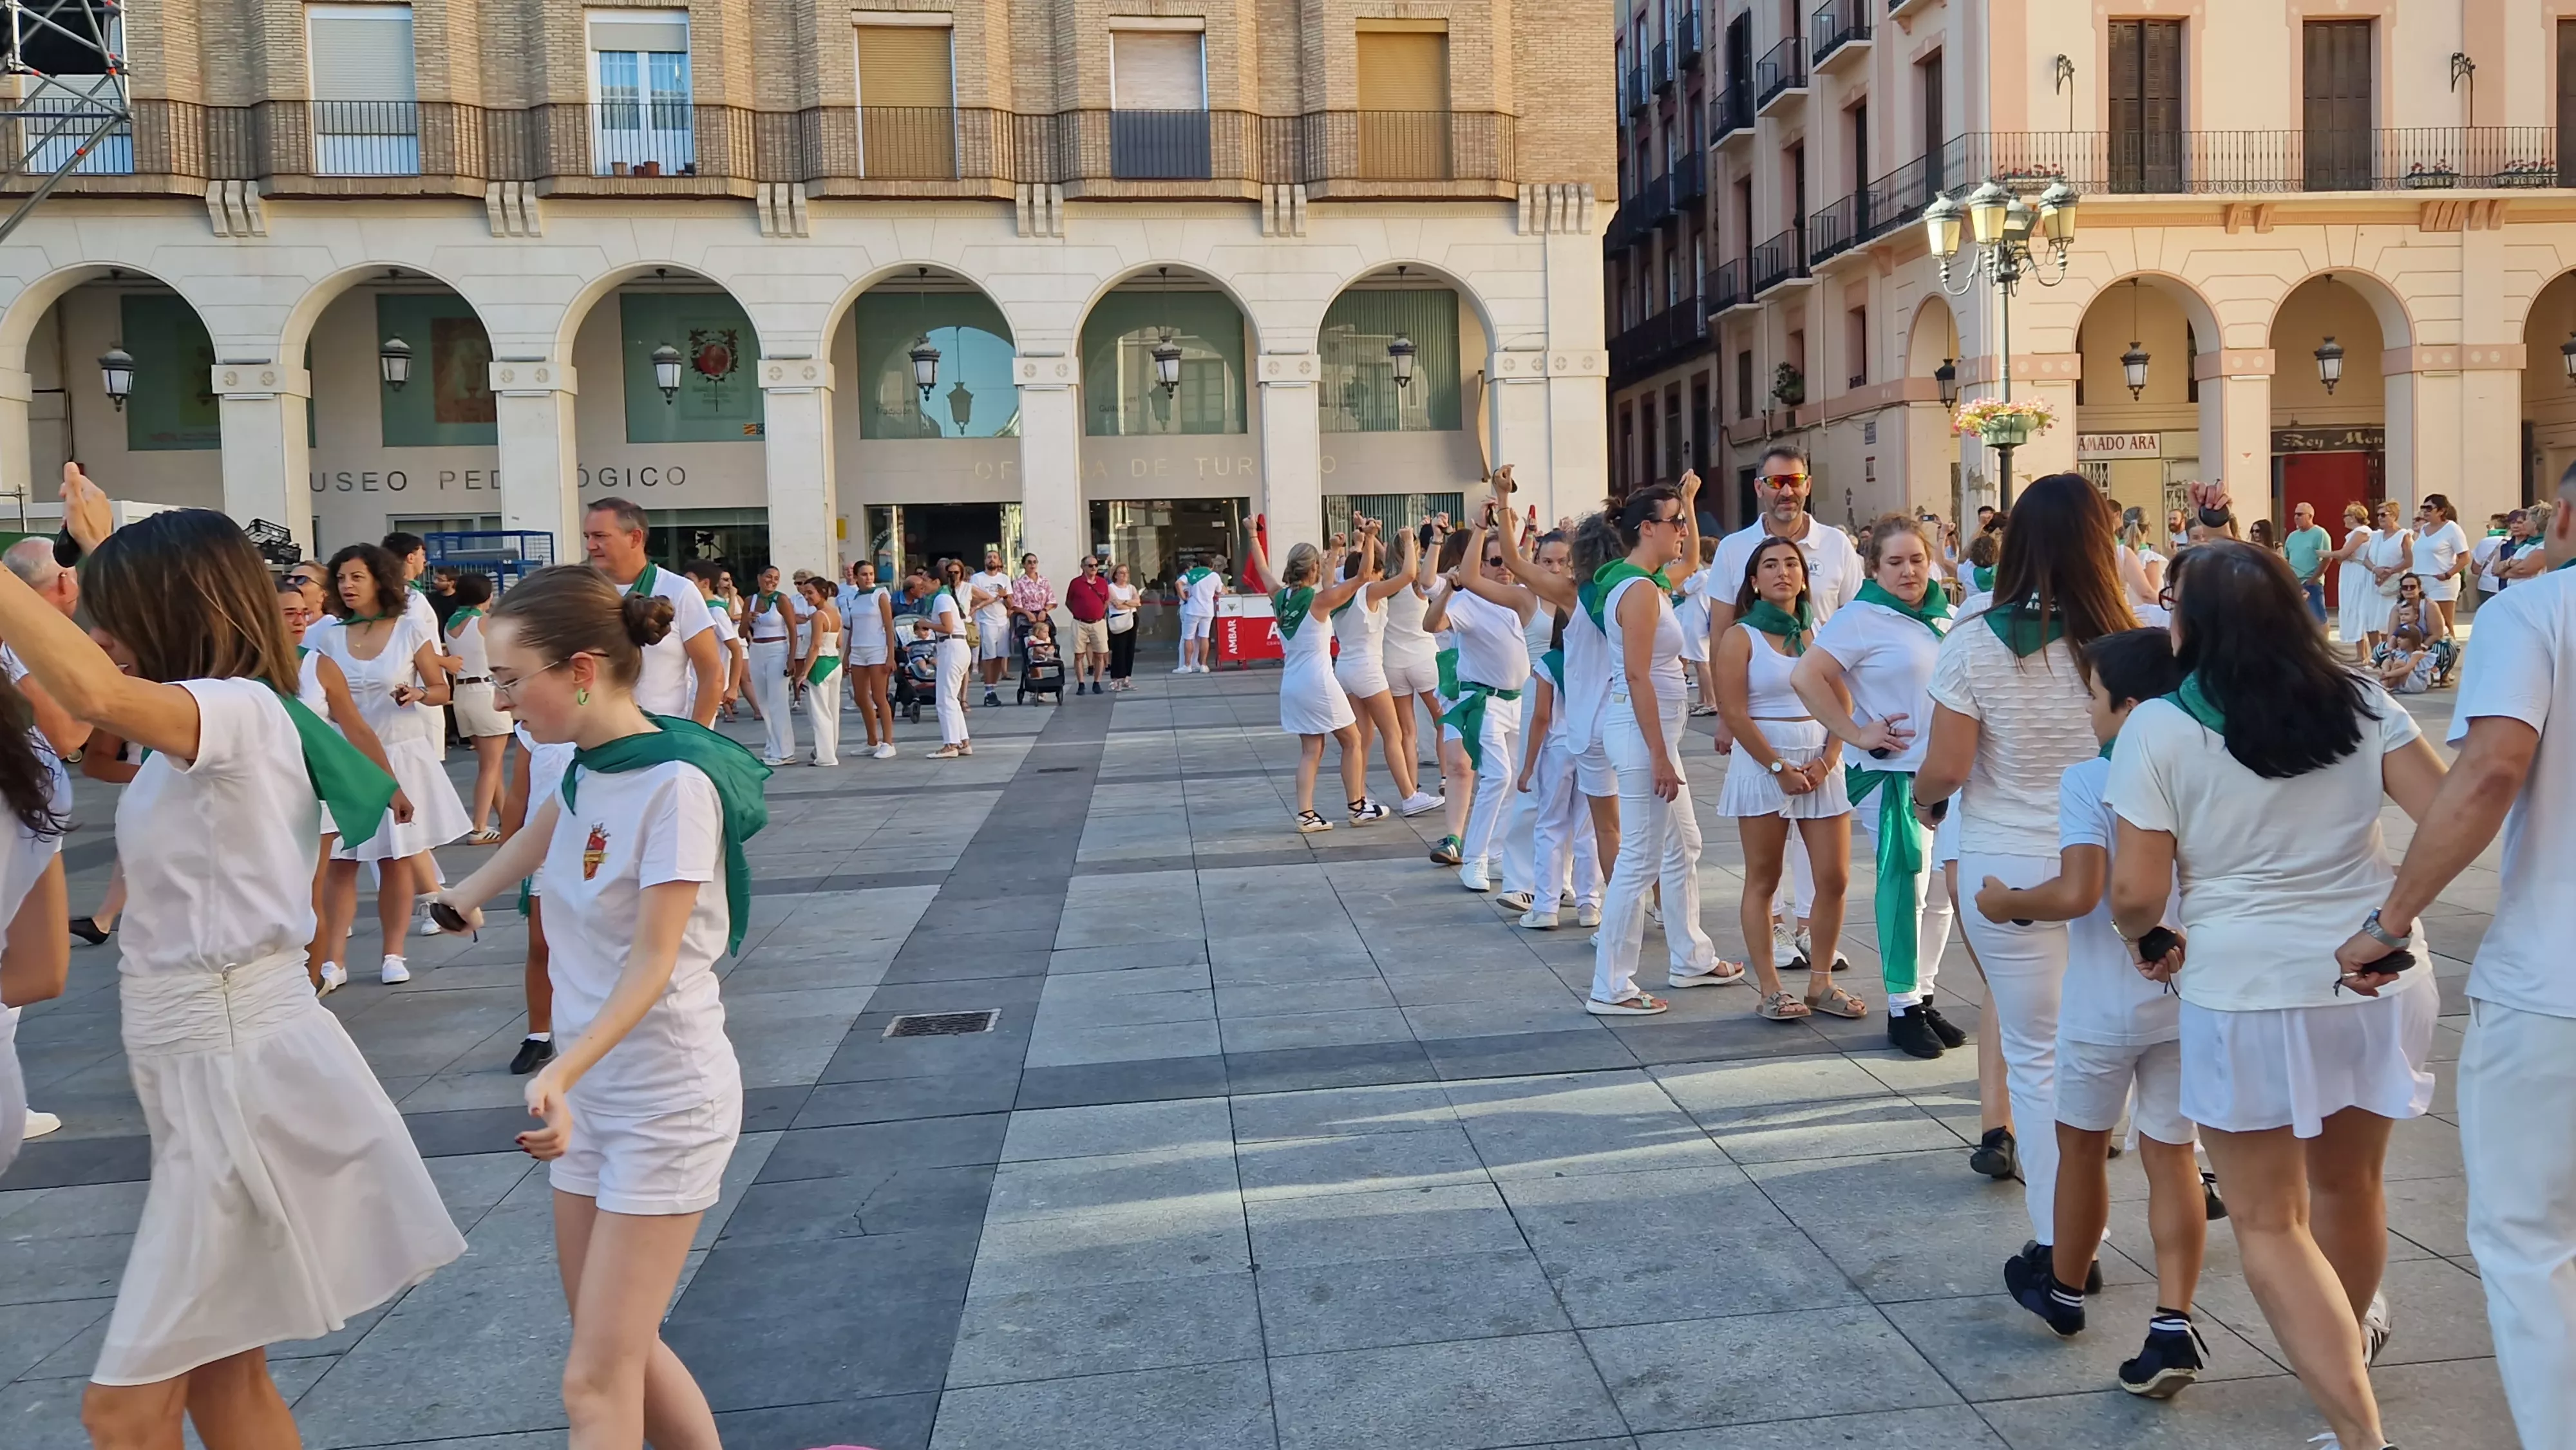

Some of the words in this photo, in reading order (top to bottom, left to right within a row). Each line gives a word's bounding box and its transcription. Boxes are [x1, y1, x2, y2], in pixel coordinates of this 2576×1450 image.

[2078, 436, 2125, 451] AMADO
[2129, 435, 2156, 450] ARA
[2281, 433, 2324, 448] Rey
[2334, 431, 2383, 446] Mon
[1131, 459, 1168, 477] DE
[309, 471, 407, 493] USEO
[1227, 619, 1238, 655] AMBAR
